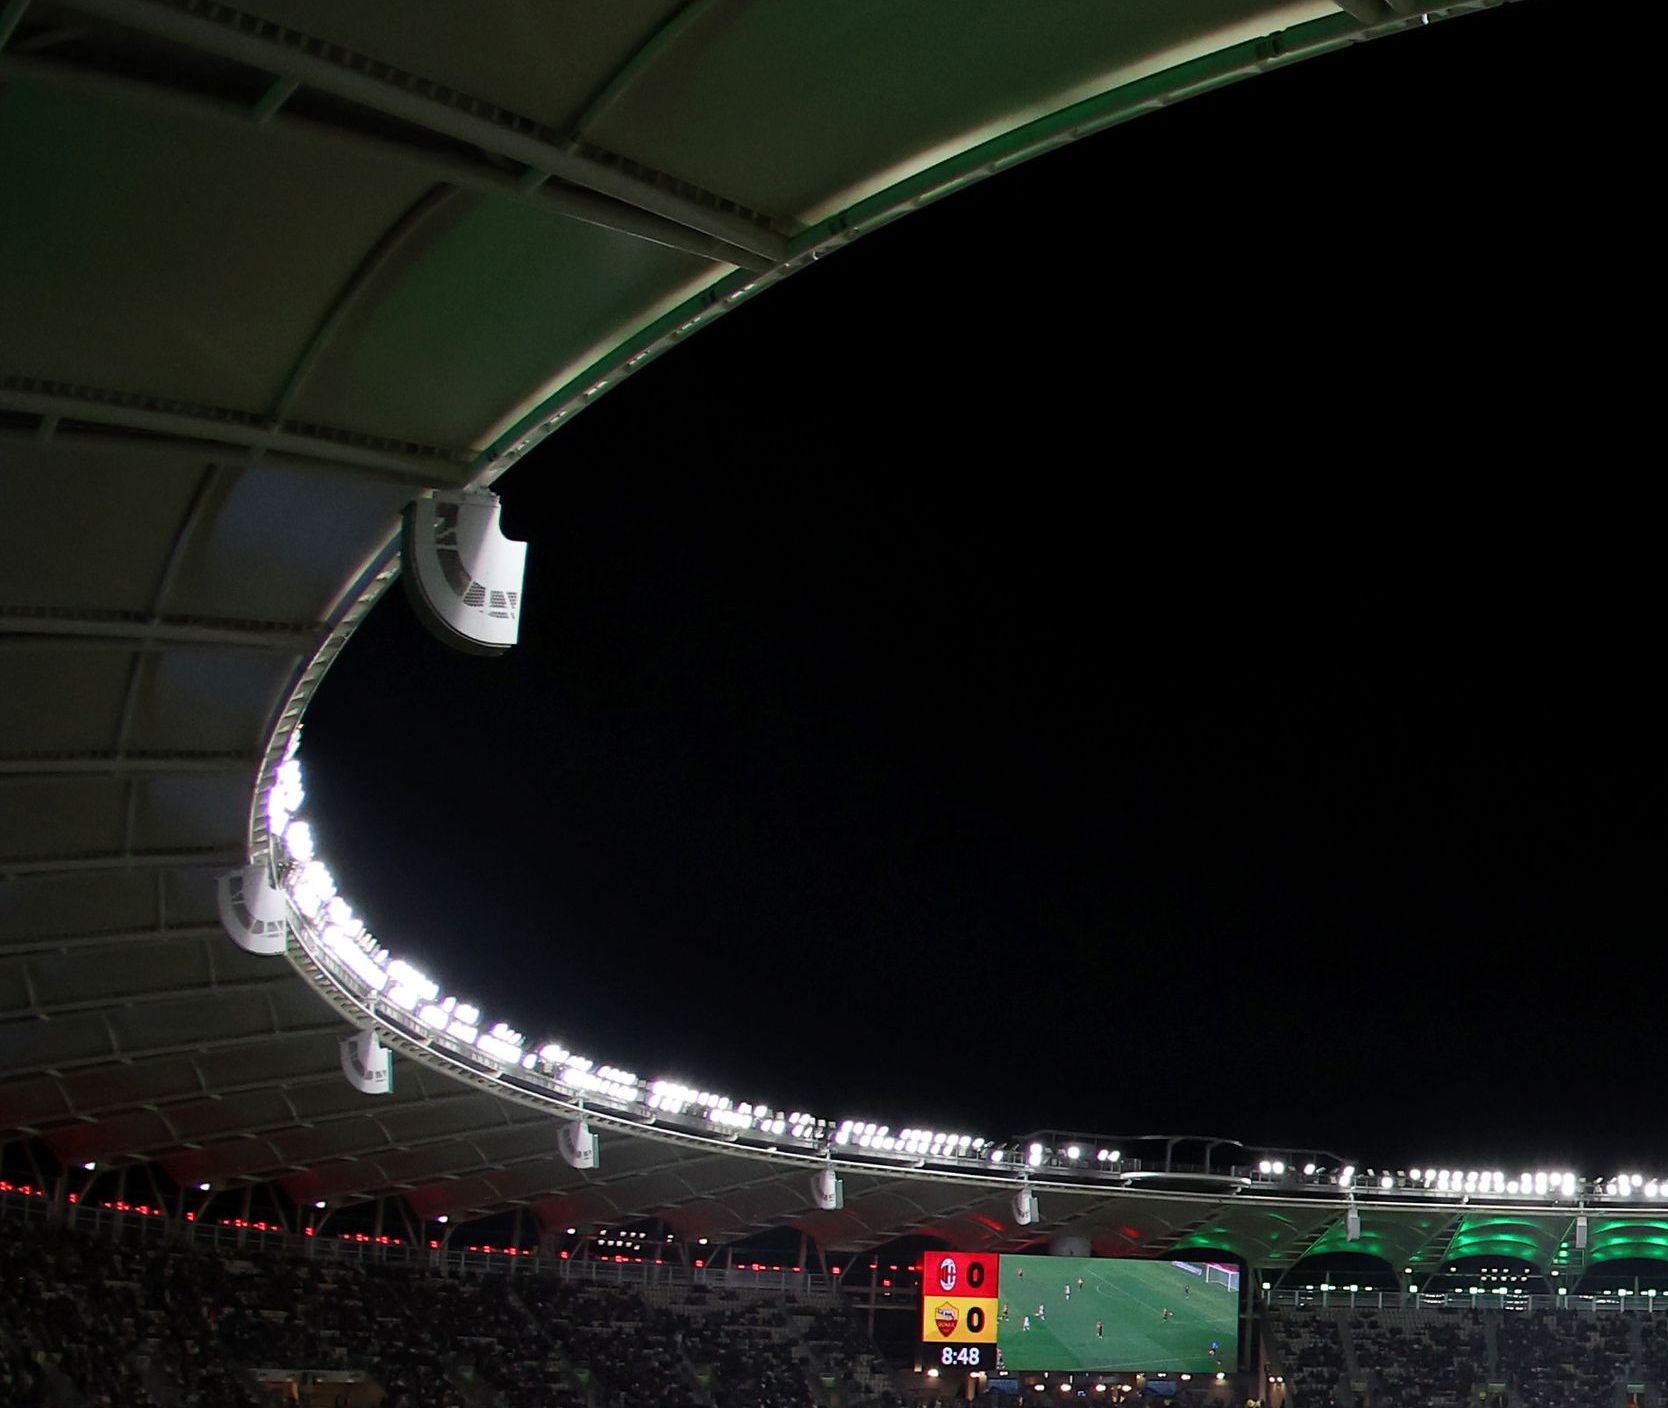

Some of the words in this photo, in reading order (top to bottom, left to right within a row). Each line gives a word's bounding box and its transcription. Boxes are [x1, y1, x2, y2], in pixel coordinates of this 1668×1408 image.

[967, 1262, 985, 1289] 0
[966, 1306, 985, 1334] 0
[941, 1347, 980, 1365] 8:48
